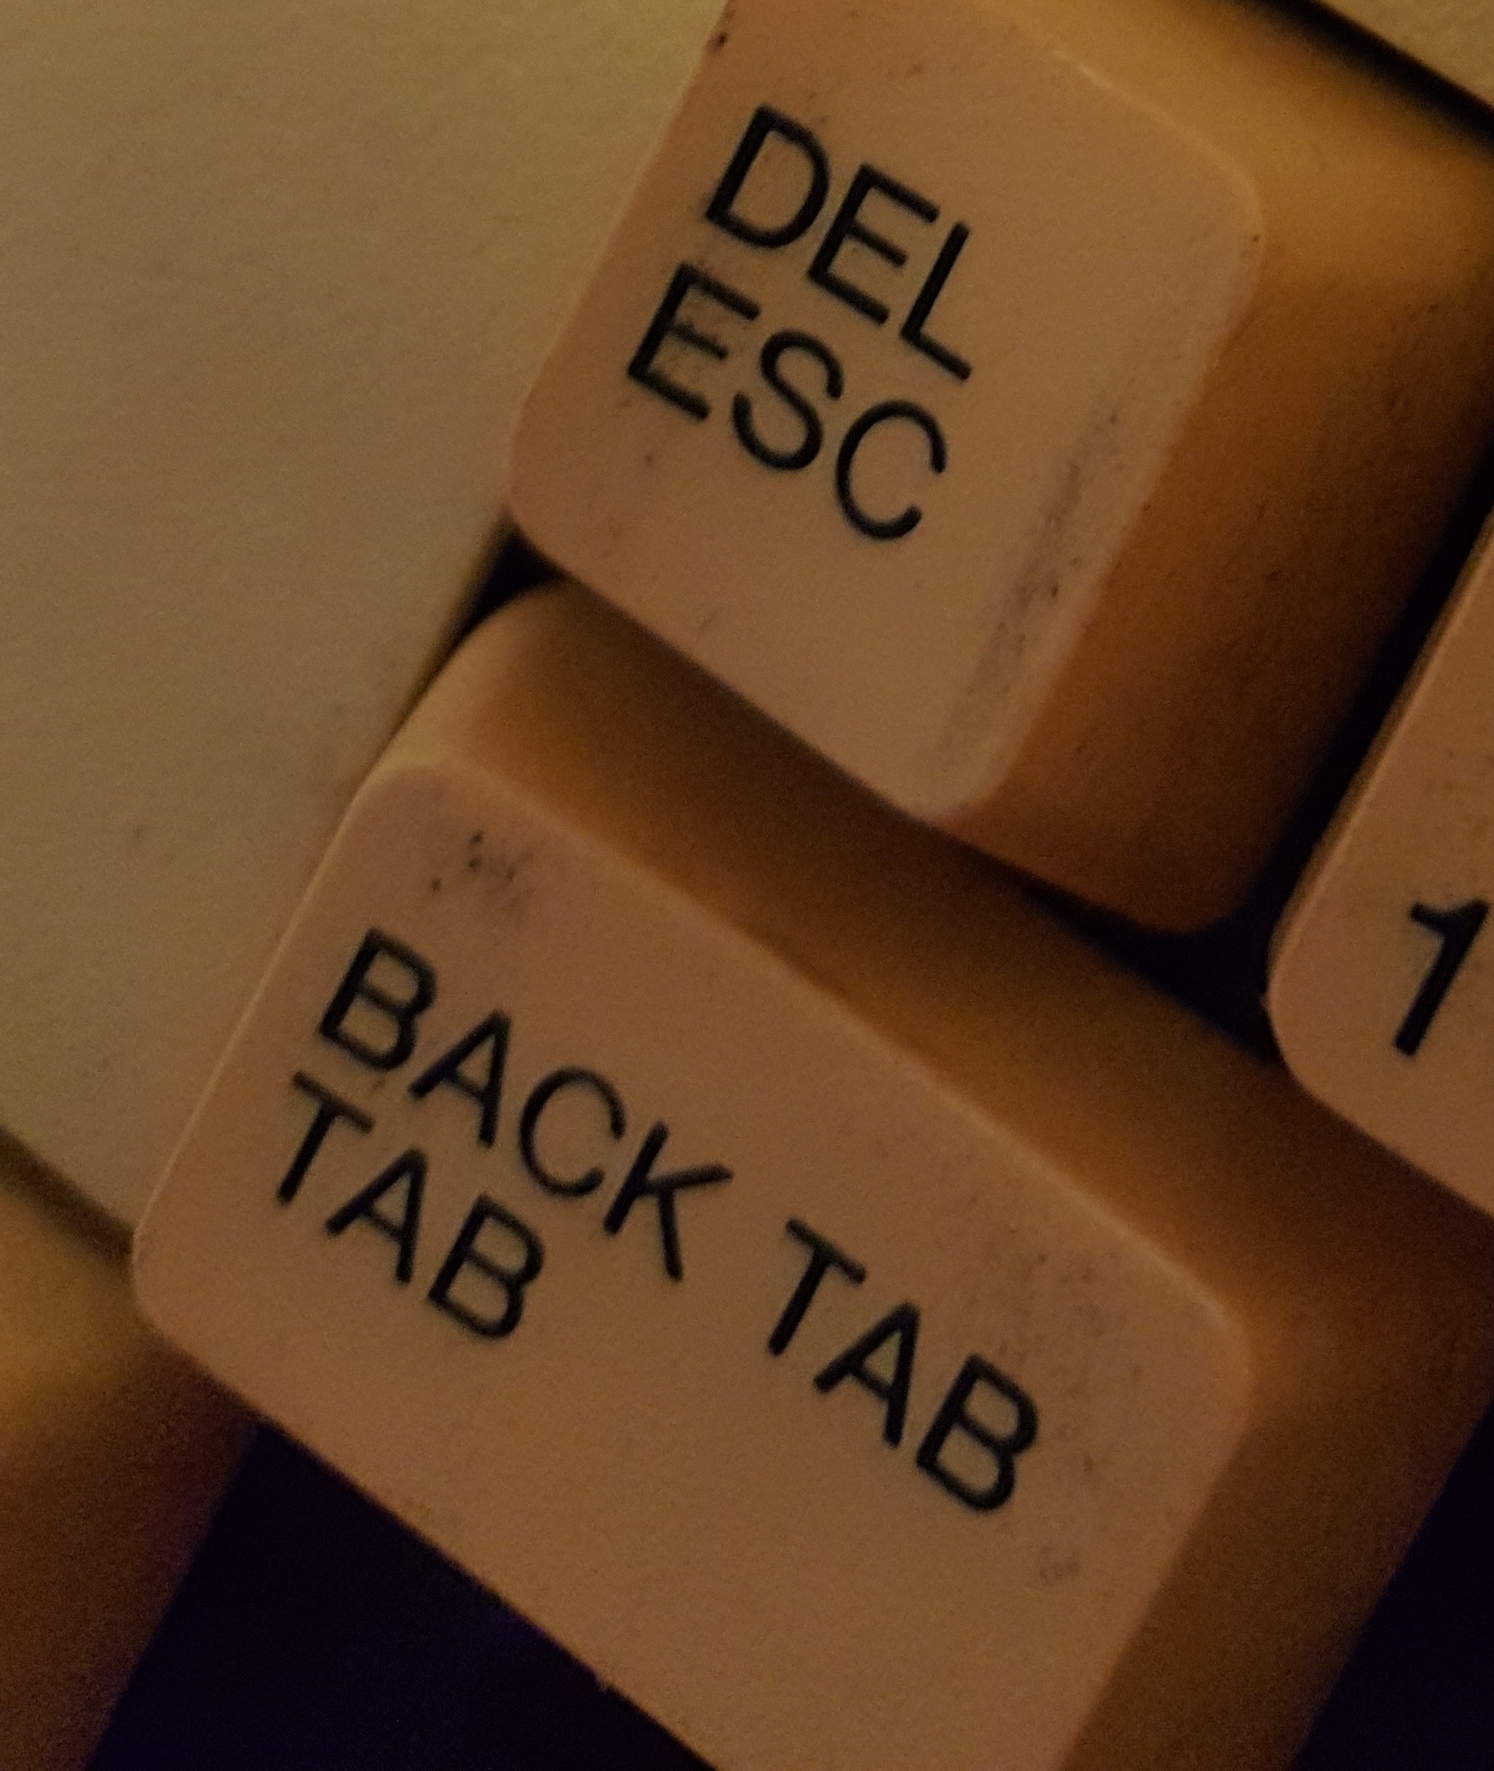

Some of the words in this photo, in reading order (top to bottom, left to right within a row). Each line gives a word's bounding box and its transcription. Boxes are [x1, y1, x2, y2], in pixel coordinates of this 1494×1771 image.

[704, 105, 972, 382] DEL
[628, 260, 947, 540] ESC
[1395, 899, 1490, 1056] 1
[276, 1071, 546, 1341] TAB
[318, 927, 734, 1282] BACK
[766, 1218, 1039, 1514] TAB
